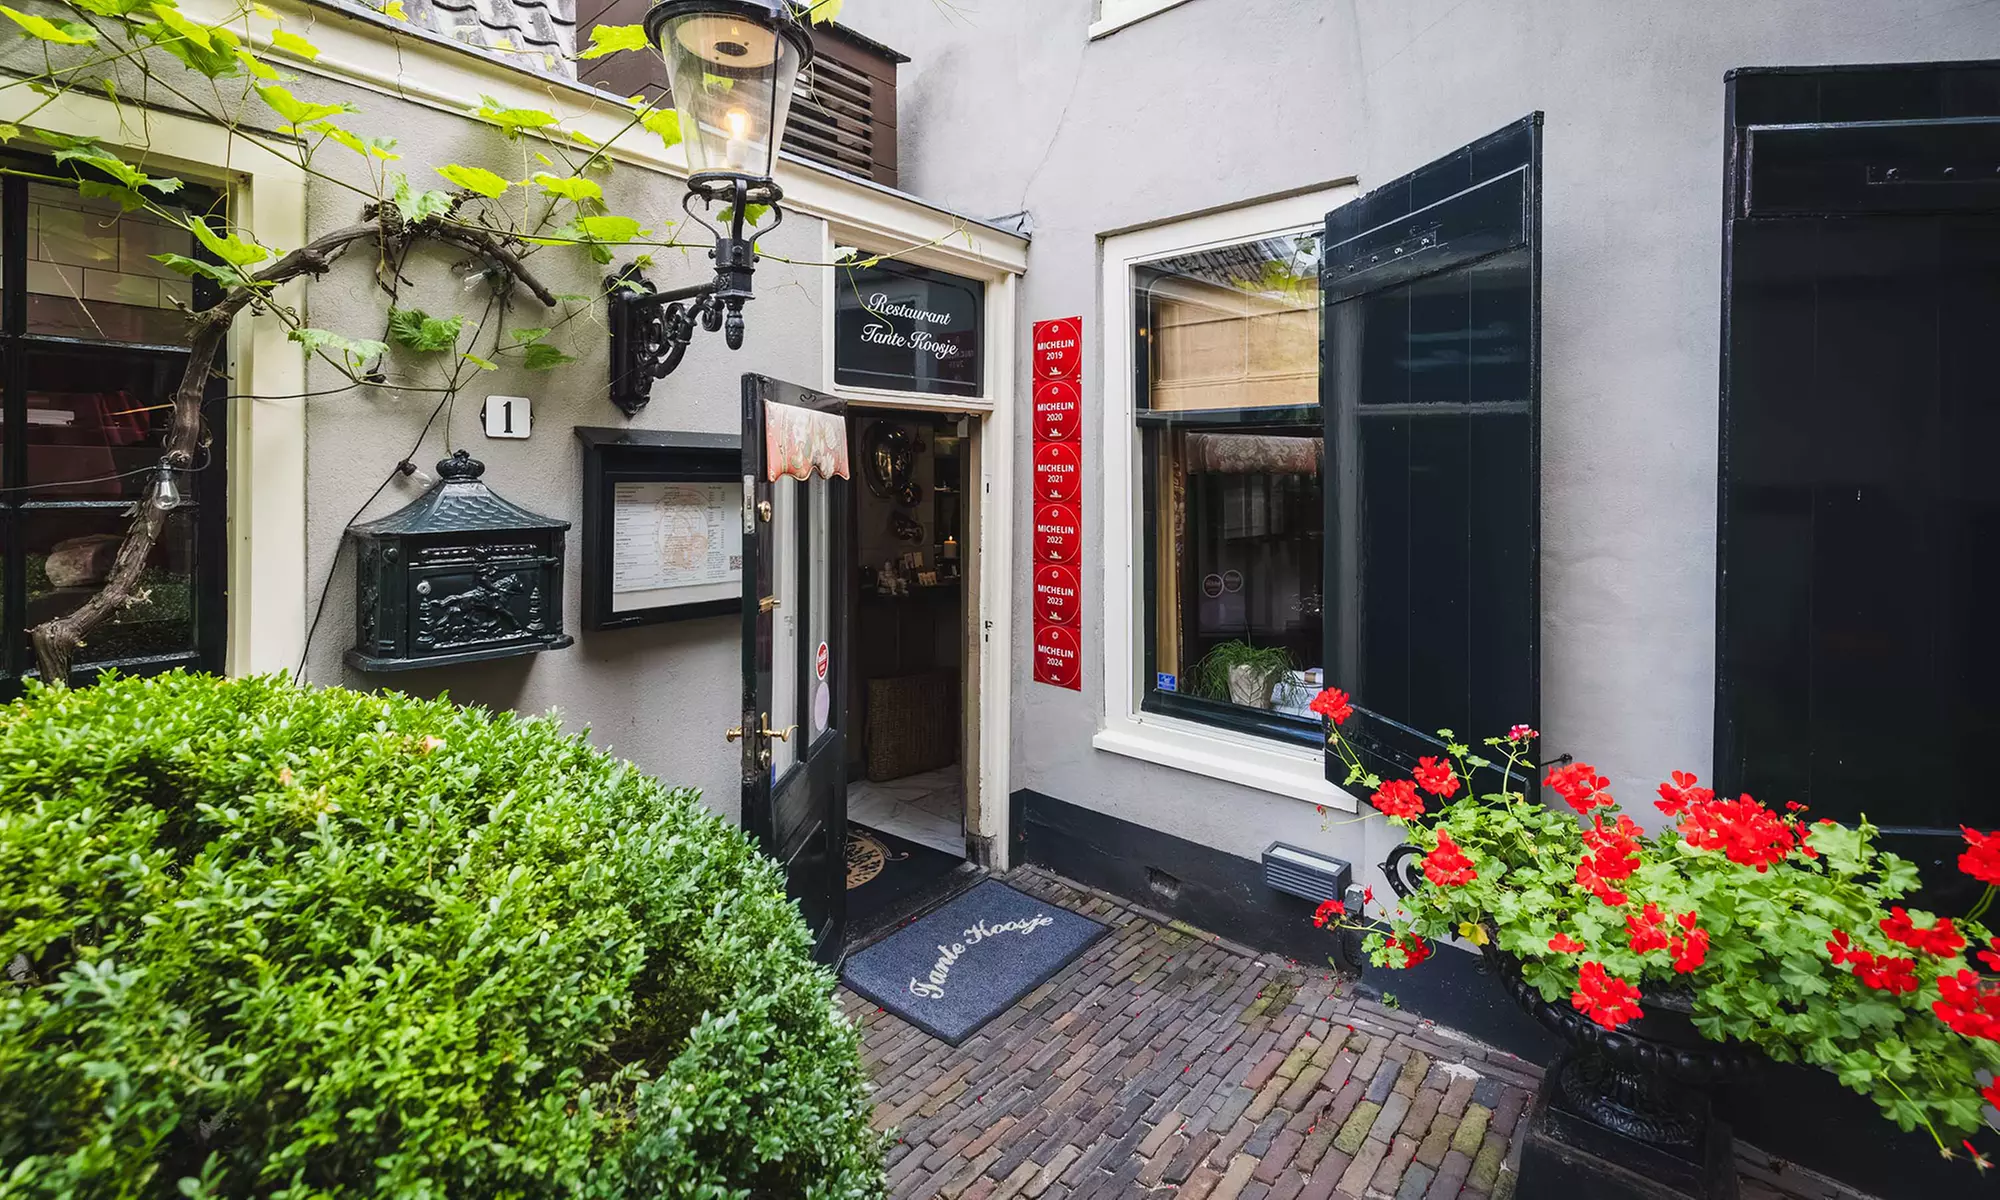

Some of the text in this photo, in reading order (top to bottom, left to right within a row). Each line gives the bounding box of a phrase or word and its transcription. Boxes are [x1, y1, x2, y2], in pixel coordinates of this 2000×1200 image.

[867, 292, 951, 325] Restaurant
[861, 324, 958, 360] Tante Koosje
[1037, 340, 1074, 350] MICHELIN
[1046, 351, 1063, 360] 2019
[1037, 402, 1074, 411] MICHELIN
[503, 401, 513, 433] 1
[1046, 412, 1063, 421] 2020
[1037, 464, 1074, 473] MICHELIN
[1046, 475, 1063, 483] 2021
[1037, 524, 1074, 535] MICHELIN
[1046, 535, 1063, 545] 2022
[1037, 584, 1074, 597] MICHELIN
[1046, 596, 1063, 606] 2023
[1037, 644, 1074, 658] MICHELIN
[1046, 657, 1063, 667] 2024
[909, 913, 1053, 999] Tante Koosje
